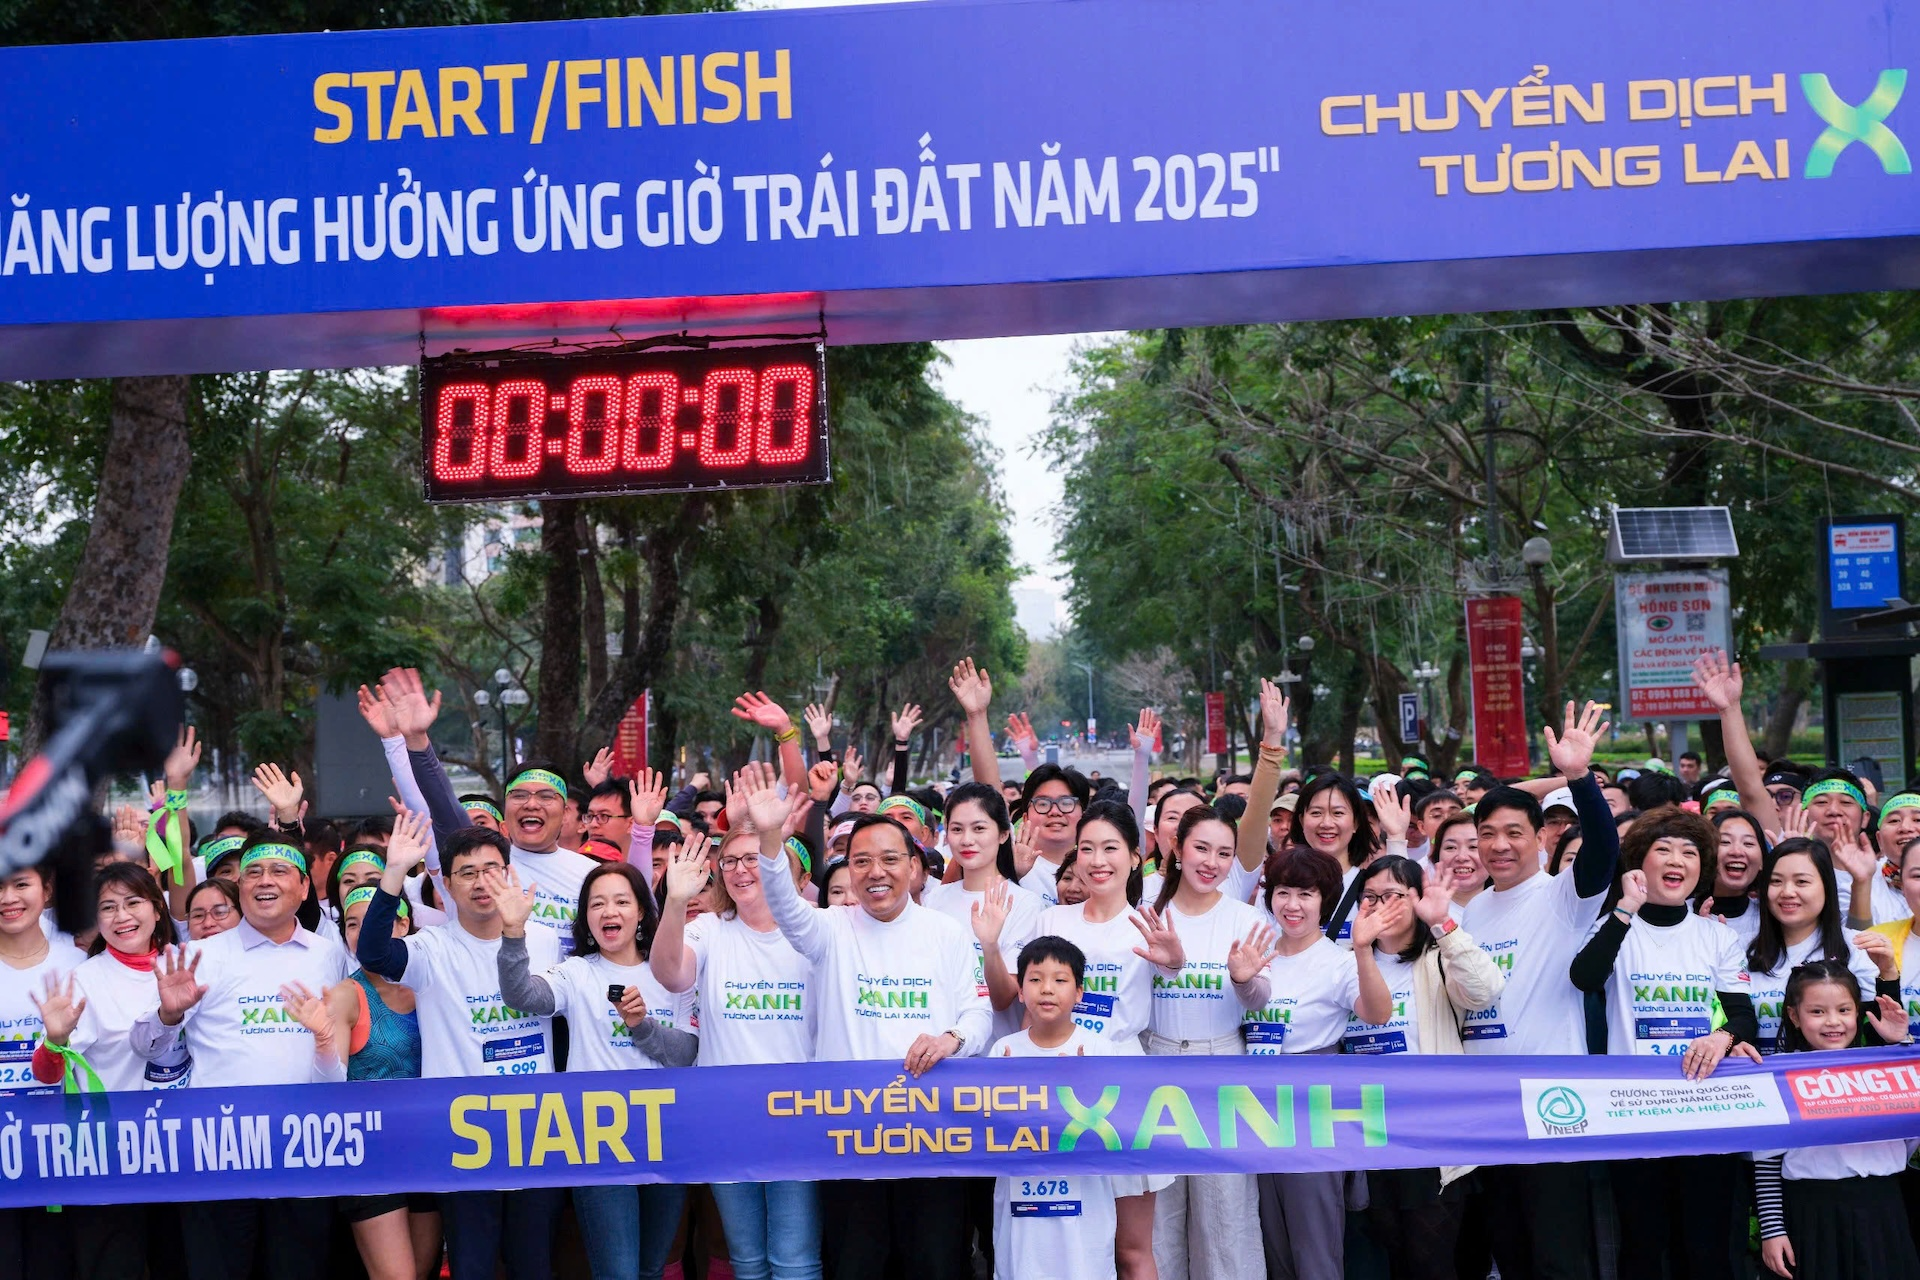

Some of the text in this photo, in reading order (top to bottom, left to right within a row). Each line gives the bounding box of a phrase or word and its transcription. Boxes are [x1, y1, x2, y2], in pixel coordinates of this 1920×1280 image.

[313, 49, 793, 144] START/FINISH
[1320, 65, 1786, 136] CHUYỂN DỊCH
[1419, 139, 1790, 195] TƯƠNG LAI
[0, 194, 113, 275] ĂNG
[126, 190, 300, 285] LƯỢNG
[314, 168, 499, 262] HƯỞNG
[513, 168, 623, 252] ỨNG
[636, 158, 721, 246] GIỜ
[734, 152, 859, 241] TRÁI
[871, 131, 981, 235] ĐẤT
[993, 142, 1120, 228] NĂM
[435, 364, 812, 480] 00:00:00
[1404, 703, 1415, 731] P
[726, 992, 801, 1010] XANH
[858, 987, 928, 1009] XANH
[1634, 985, 1708, 1003] XANH
[903, 1012, 930, 1020] XANH
[767, 1075, 1049, 1118] CHUYỂN DỊCH
[1610, 1088, 1658, 1098] CHƯƠNG
[1661, 1088, 1693, 1097] TRÌNH
[1696, 1084, 1729, 1094] QUỐC
[1056, 1083, 1388, 1152] XANH
[1606, 1107, 1635, 1118] TIẾT
[1639, 1105, 1672, 1117] KIỆM
[1676, 1104, 1695, 1114] VÀ
[1699, 1102, 1731, 1113] HIỆU
[1807, 1101, 1916, 1115] INDUSTRY AND TRADE
[32, 1110, 108, 1179] TRÁI
[118, 1100, 182, 1175] ĐẤT
[192, 1104, 273, 1171] NĂM
[450, 1088, 676, 1170] START
[827, 1122, 1049, 1155] TƯƠNG LAI
[1541, 1119, 1588, 1135] VNEEP
[1022, 1180, 1069, 1196] 3.678
